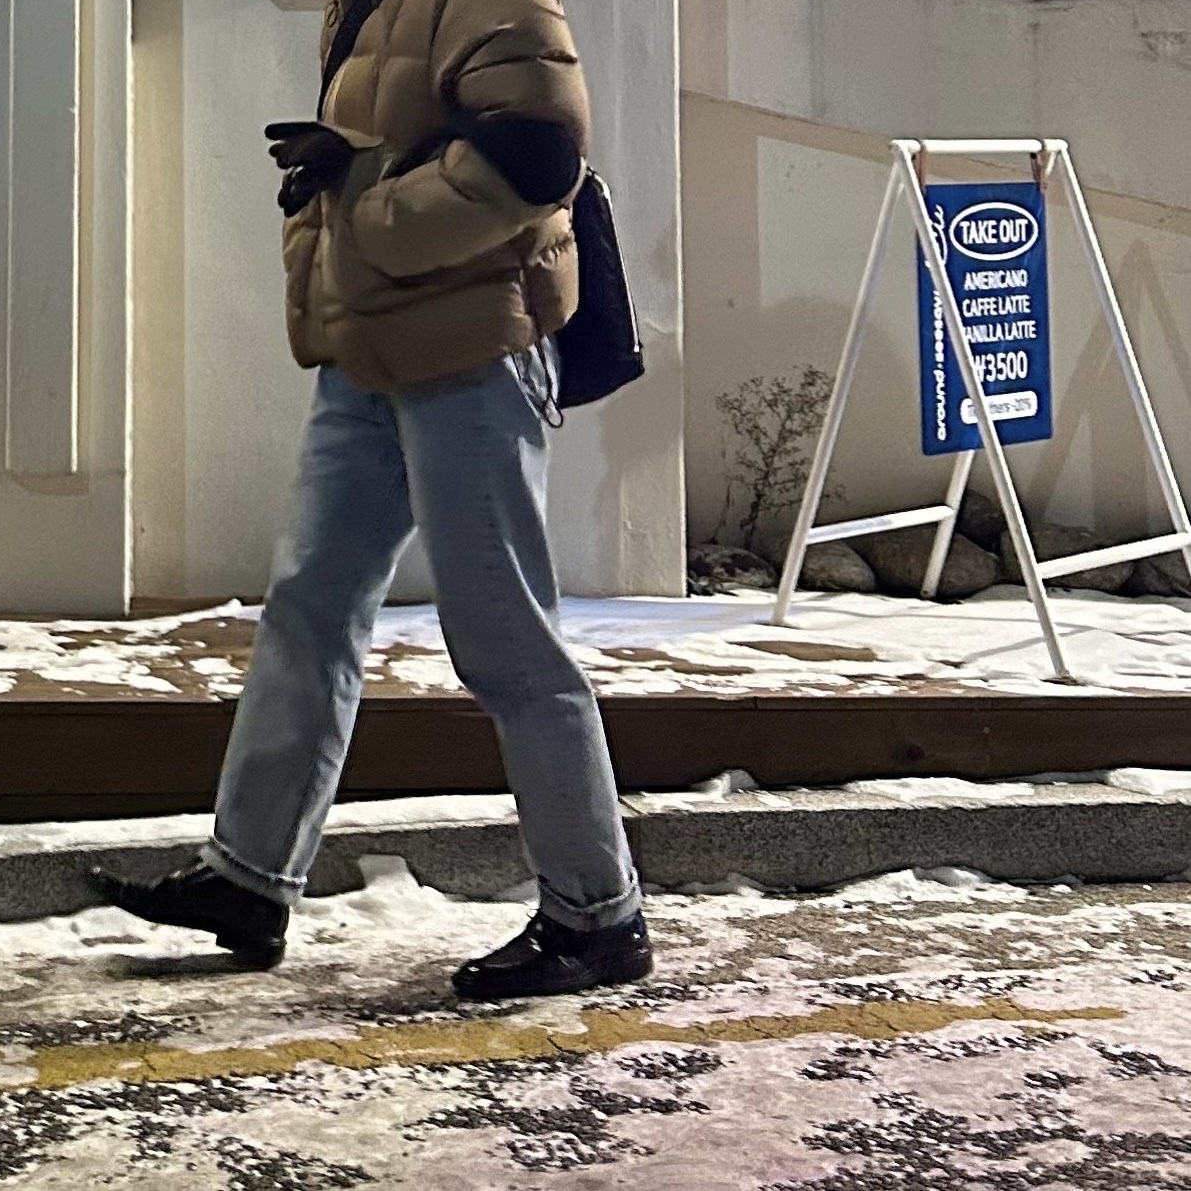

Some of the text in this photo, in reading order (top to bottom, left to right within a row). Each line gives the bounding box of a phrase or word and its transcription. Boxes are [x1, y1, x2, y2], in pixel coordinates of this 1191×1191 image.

[960, 218, 1029, 245] TAKE OUT
[964, 269, 1028, 291] AMERICANO
[962, 294, 1031, 317] CAFFE LATTE
[963, 320, 1036, 344] ANILLA LATTE
